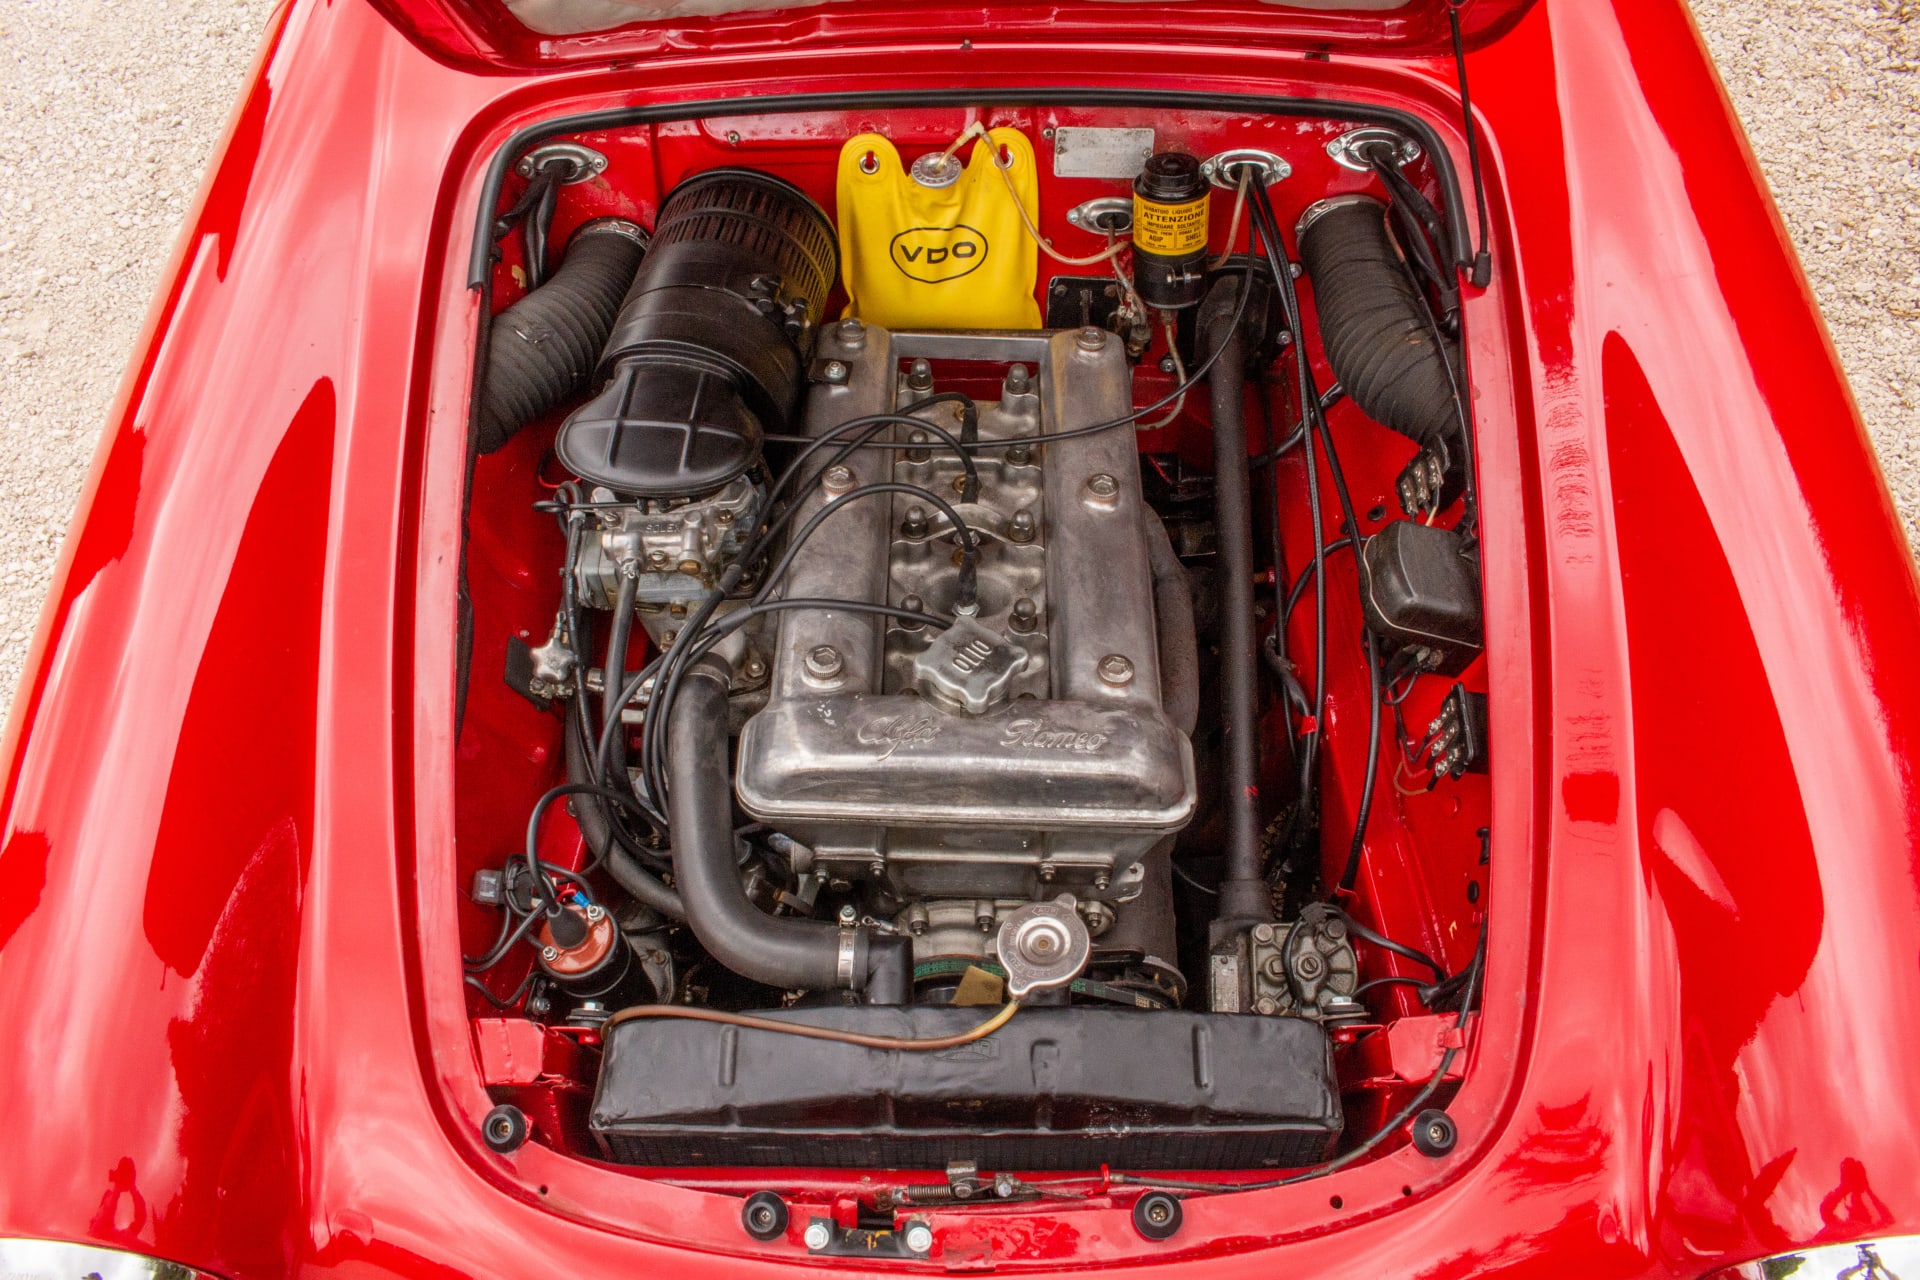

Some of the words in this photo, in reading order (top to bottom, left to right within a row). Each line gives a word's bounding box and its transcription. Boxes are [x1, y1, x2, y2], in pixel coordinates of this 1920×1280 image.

[1144, 209, 1205, 222] ATTENZIONE
[1149, 234, 1164, 242] AGIP
[1185, 231, 1202, 242] SHELL
[900, 241, 977, 264] VDO
[952, 640, 993, 674] OLIO
[857, 715, 942, 761] Alfa
[1000, 718, 1107, 750] Romeo
